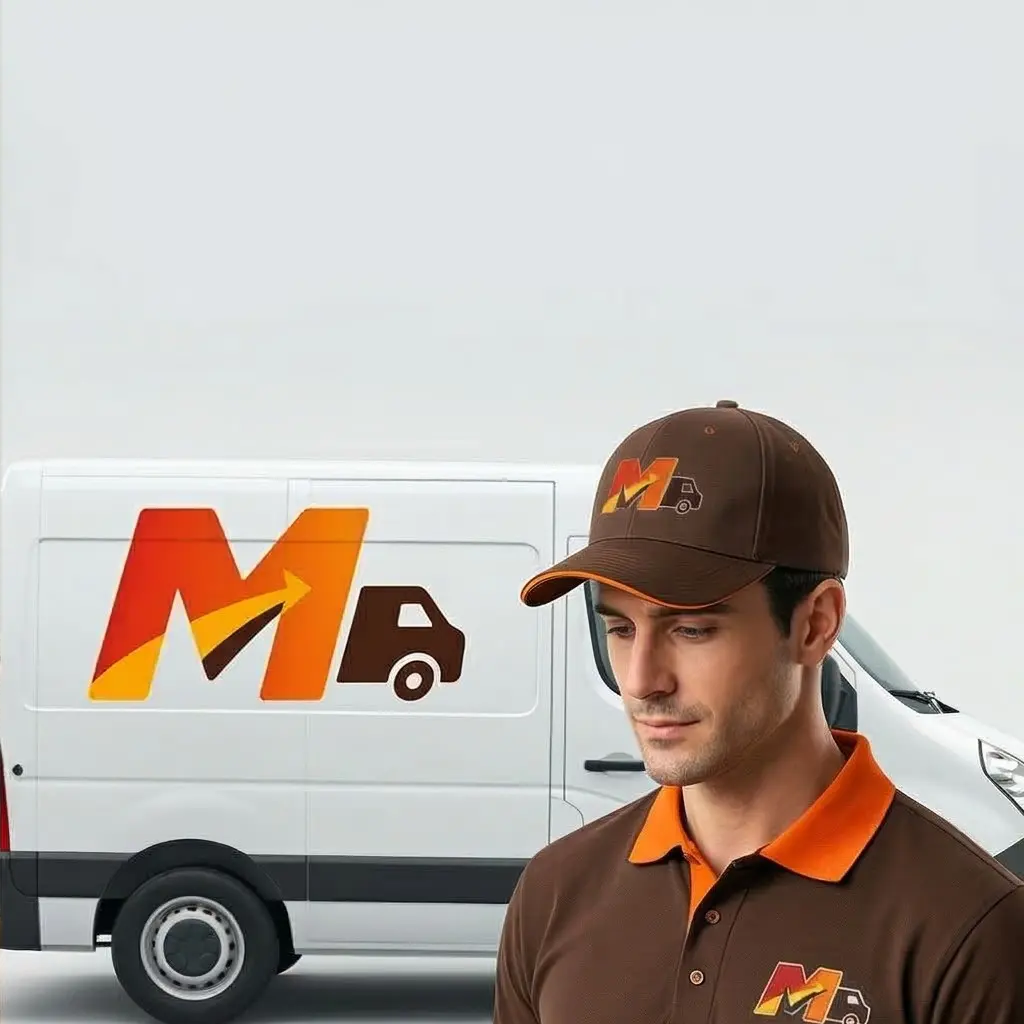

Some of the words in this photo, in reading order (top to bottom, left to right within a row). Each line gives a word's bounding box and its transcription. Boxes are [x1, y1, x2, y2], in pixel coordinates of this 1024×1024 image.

[602, 457, 679, 514] M
[88, 508, 369, 700] M
[753, 961, 843, 1024] M
